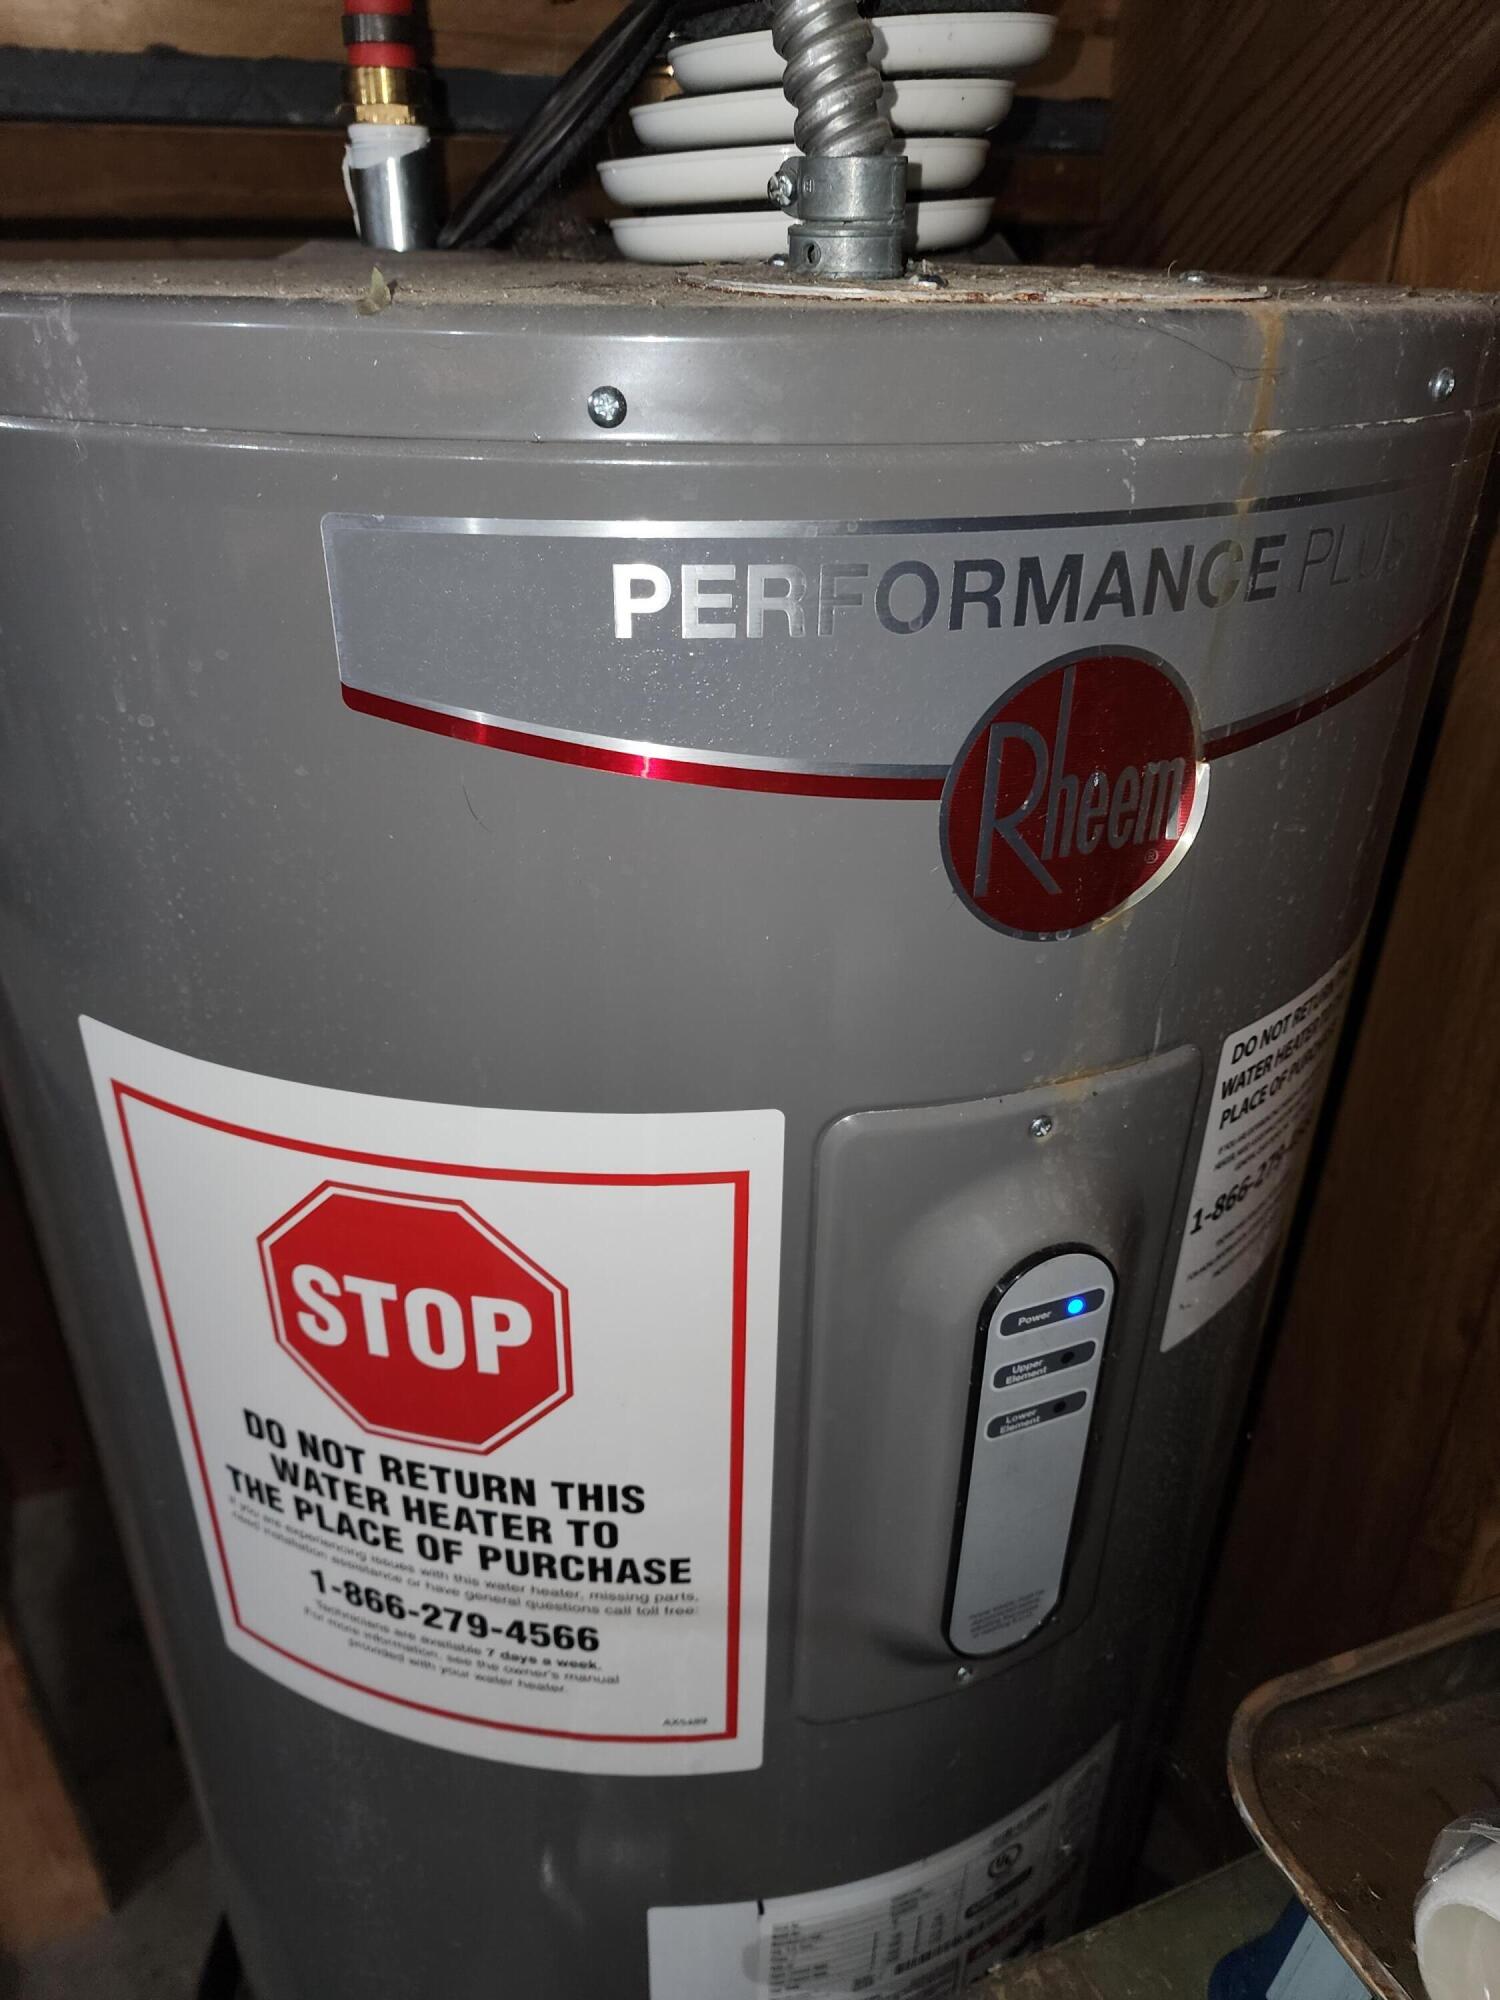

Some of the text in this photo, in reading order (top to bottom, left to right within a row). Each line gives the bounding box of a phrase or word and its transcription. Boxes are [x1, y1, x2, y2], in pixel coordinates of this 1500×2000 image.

[612, 510, 1409, 640] PERFORMANCE PLUS
[973, 664, 1187, 897] Rheem
[1231, 1035, 1258, 1065] DO
[1258, 1013, 1292, 1049] NOT
[1220, 1053, 1274, 1100] WATER
[1218, 1084, 1269, 1131] PLACE
[291, 1263, 533, 1375] STOP
[1017, 1311, 1052, 1326] Power
[1004, 1366, 1048, 1385] Element
[1011, 1359, 1044, 1374] Upper
[999, 1415, 1041, 1434] Element
[1005, 1409, 1038, 1424] Lower
[243, 1408, 645, 1514] DO NOT RETURN THIS
[270, 1452, 619, 1549] WATER HEATER TO
[225, 1464, 692, 1585] THE PLACE OF PURCHASE
[310, 1569, 600, 1652] 1-866-279-4566
[464, 1589, 521, 1607] general
[525, 1598, 600, 1615] questions
[604, 1604, 632, 1616] call
[636, 1605, 659, 1616] toll
[485, 1579, 525, 1593] water
[589, 1590, 650, 1605] missing
[500, 1650, 537, 1665] days
